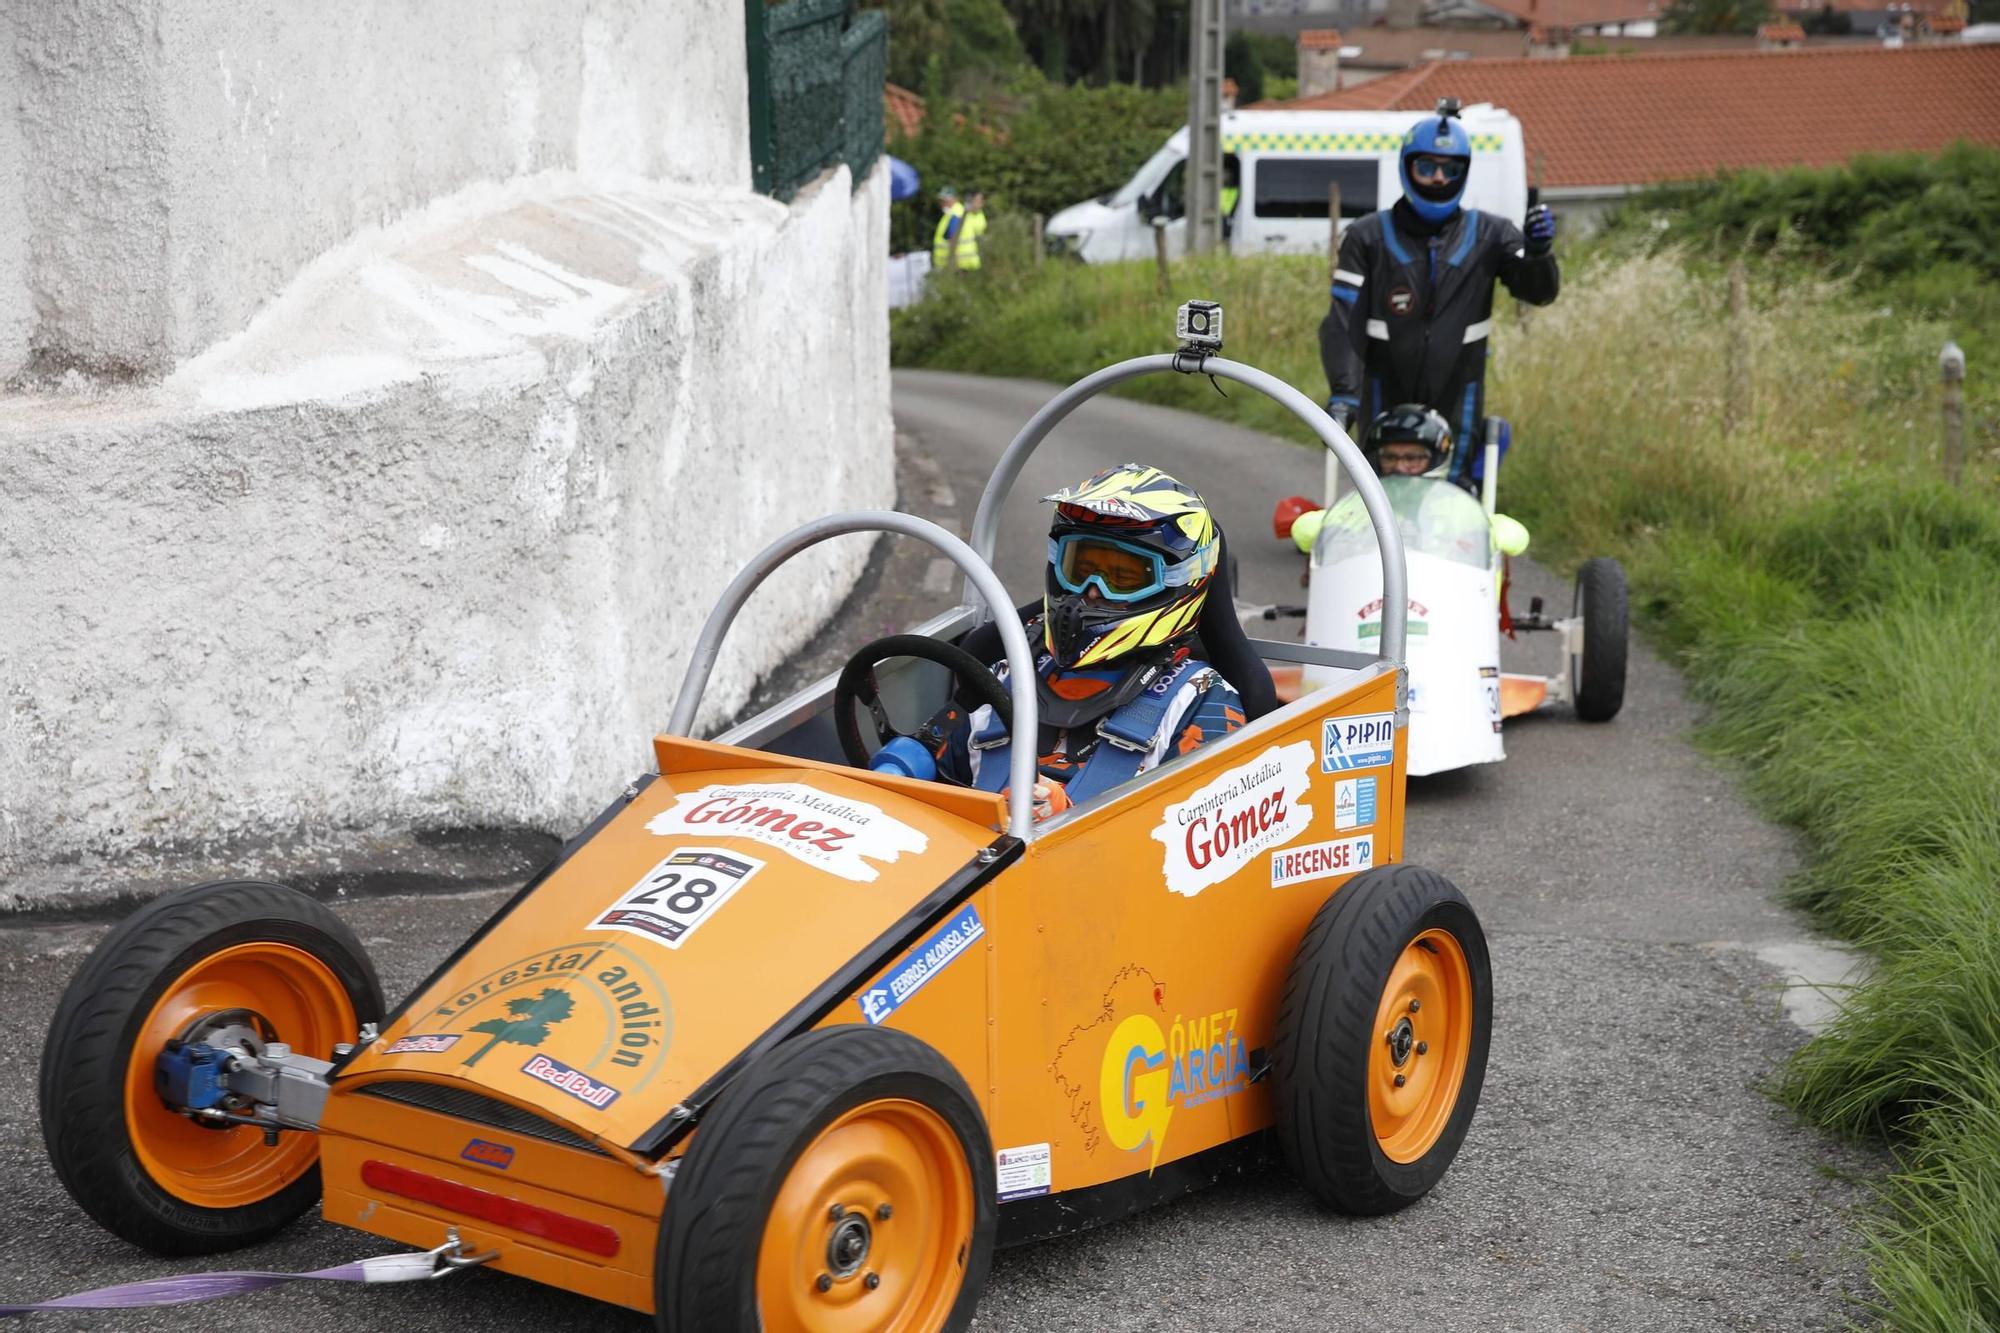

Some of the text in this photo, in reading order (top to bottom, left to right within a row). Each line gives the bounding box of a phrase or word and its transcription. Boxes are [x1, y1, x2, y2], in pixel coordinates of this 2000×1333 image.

[1346, 720, 1392, 745] PIPIN
[709, 788, 871, 827] Carpintería Metálica
[1177, 761, 1282, 826] Carpintería Metálica
[684, 797, 855, 852] Gómez
[1185, 786, 1288, 870] Gómez
[1286, 844, 1349, 878] RECENSE
[1356, 841, 1370, 864] 70
[626, 873, 717, 914] 28
[889, 958, 928, 997] FERROS
[597, 966, 661, 1067] andión
